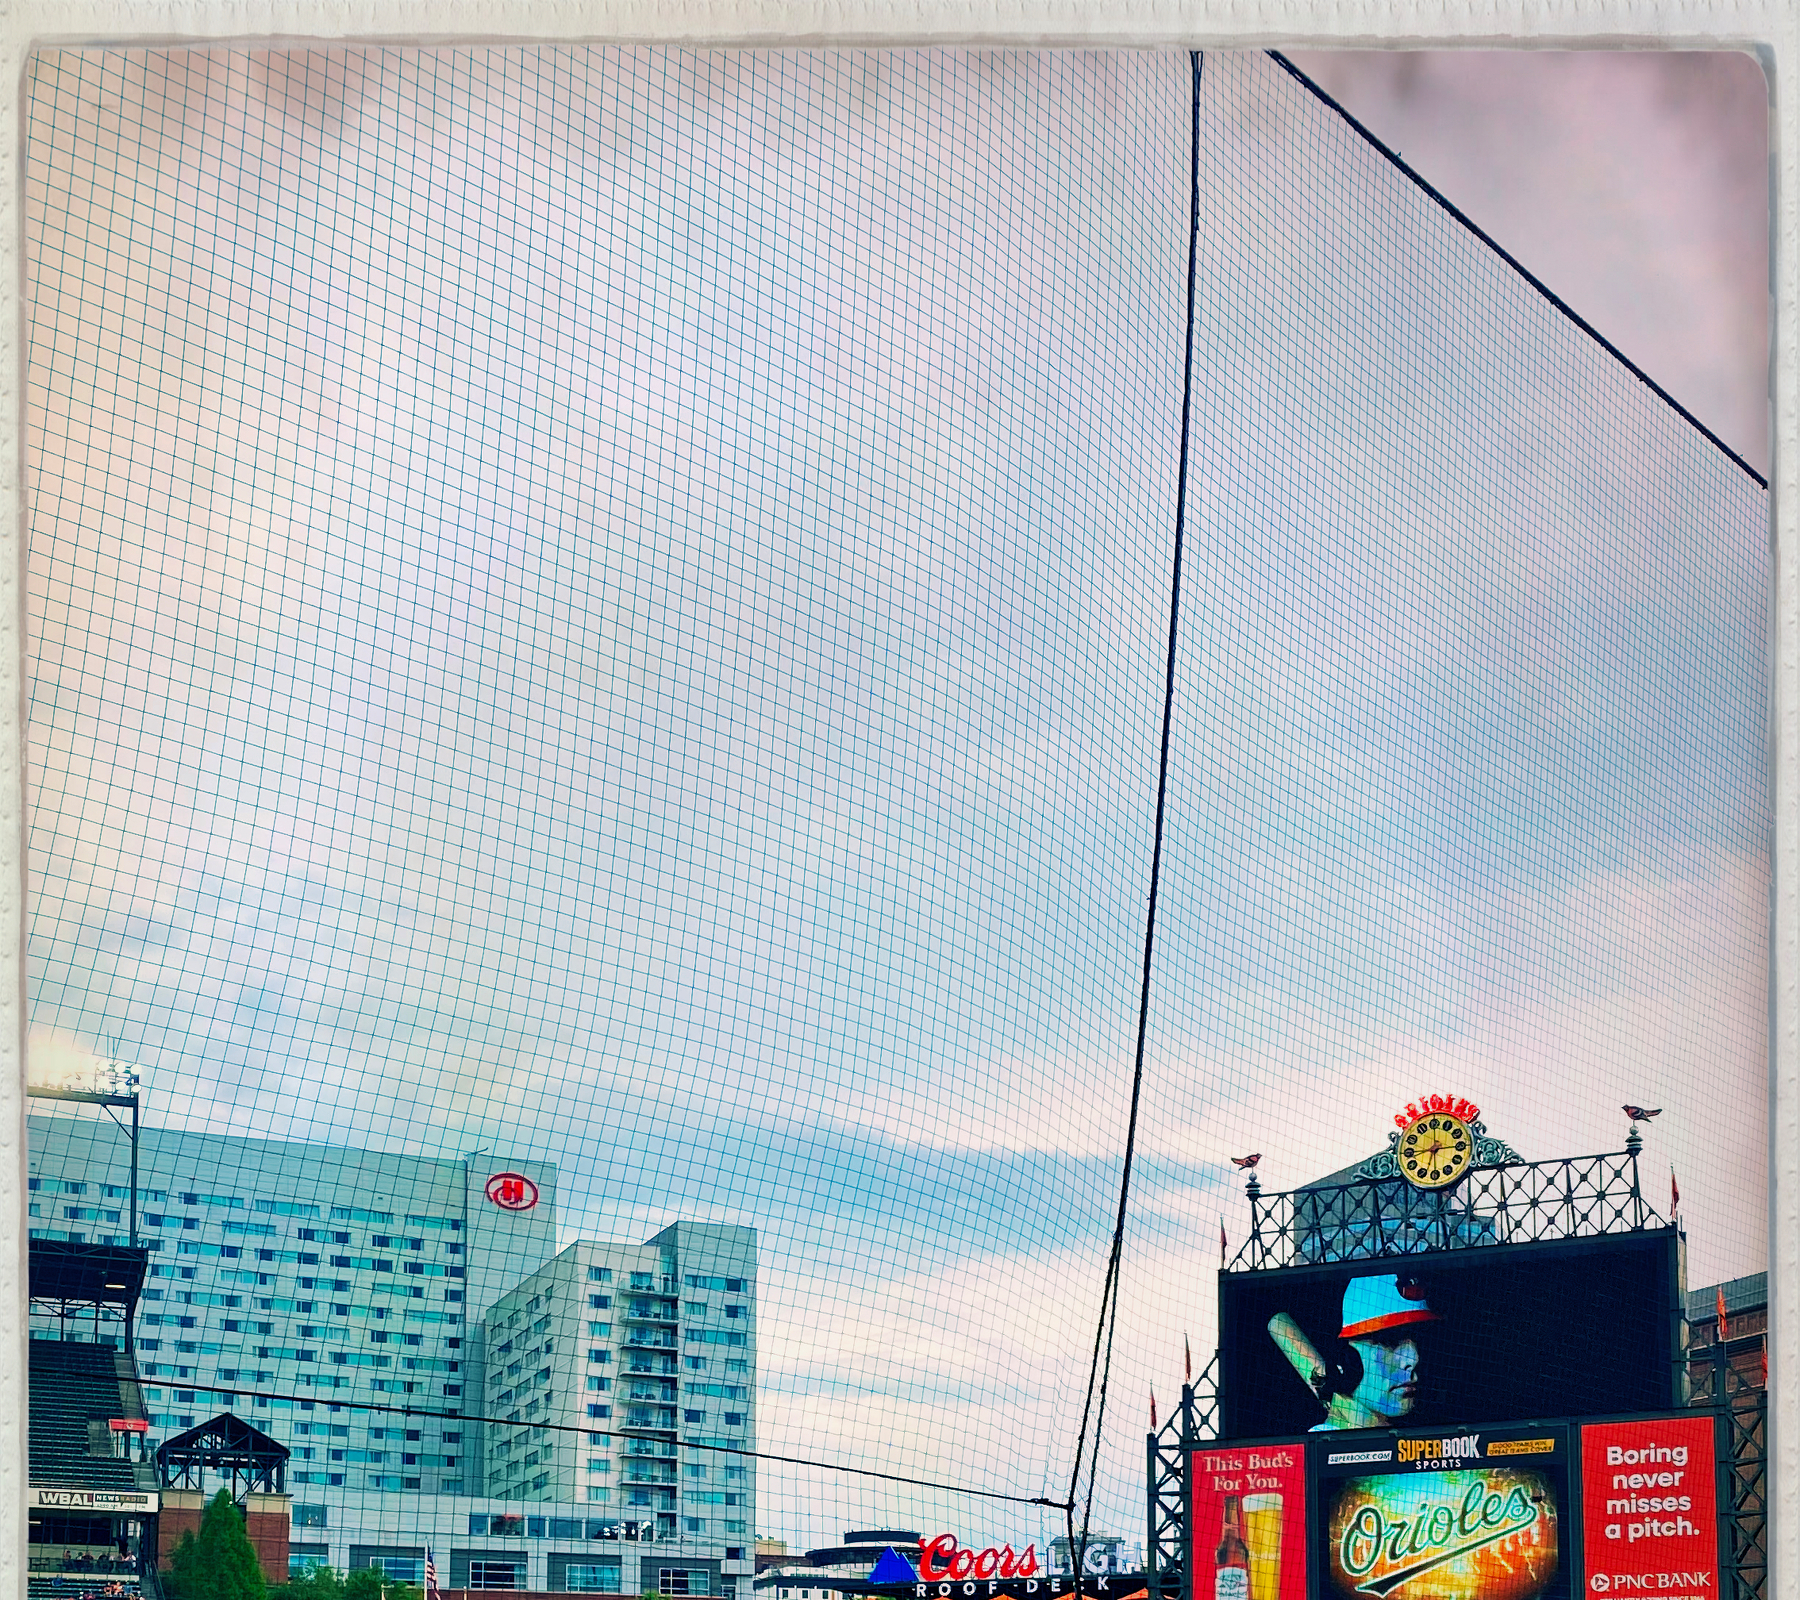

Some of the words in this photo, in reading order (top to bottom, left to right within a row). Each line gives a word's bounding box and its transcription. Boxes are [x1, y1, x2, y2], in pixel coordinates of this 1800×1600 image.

[1398, 1434, 1481, 1462] SUPERBOOK
[1606, 1442, 1688, 1467] Boring
[1204, 1455, 1243, 1472] This
[1248, 1451, 1294, 1470] Bud's
[1415, 1459, 1461, 1470] SPORTS
[1213, 1475, 1242, 1492] For
[1246, 1473, 1283, 1490] You.
[1612, 1471, 1684, 1490] never
[40, 1491, 93, 1506] WBAL
[1606, 1492, 1692, 1515] misses
[1340, 1479, 1539, 1597] Orioles
[1604, 1523, 1621, 1539] a
[1627, 1515, 1700, 1543] pitch.
[918, 1533, 1040, 1582] Coors
[916, 1581, 998, 1597] ROOF
[1612, 1573, 1655, 1590] PNC
[1656, 1571, 1711, 1588] BANK
